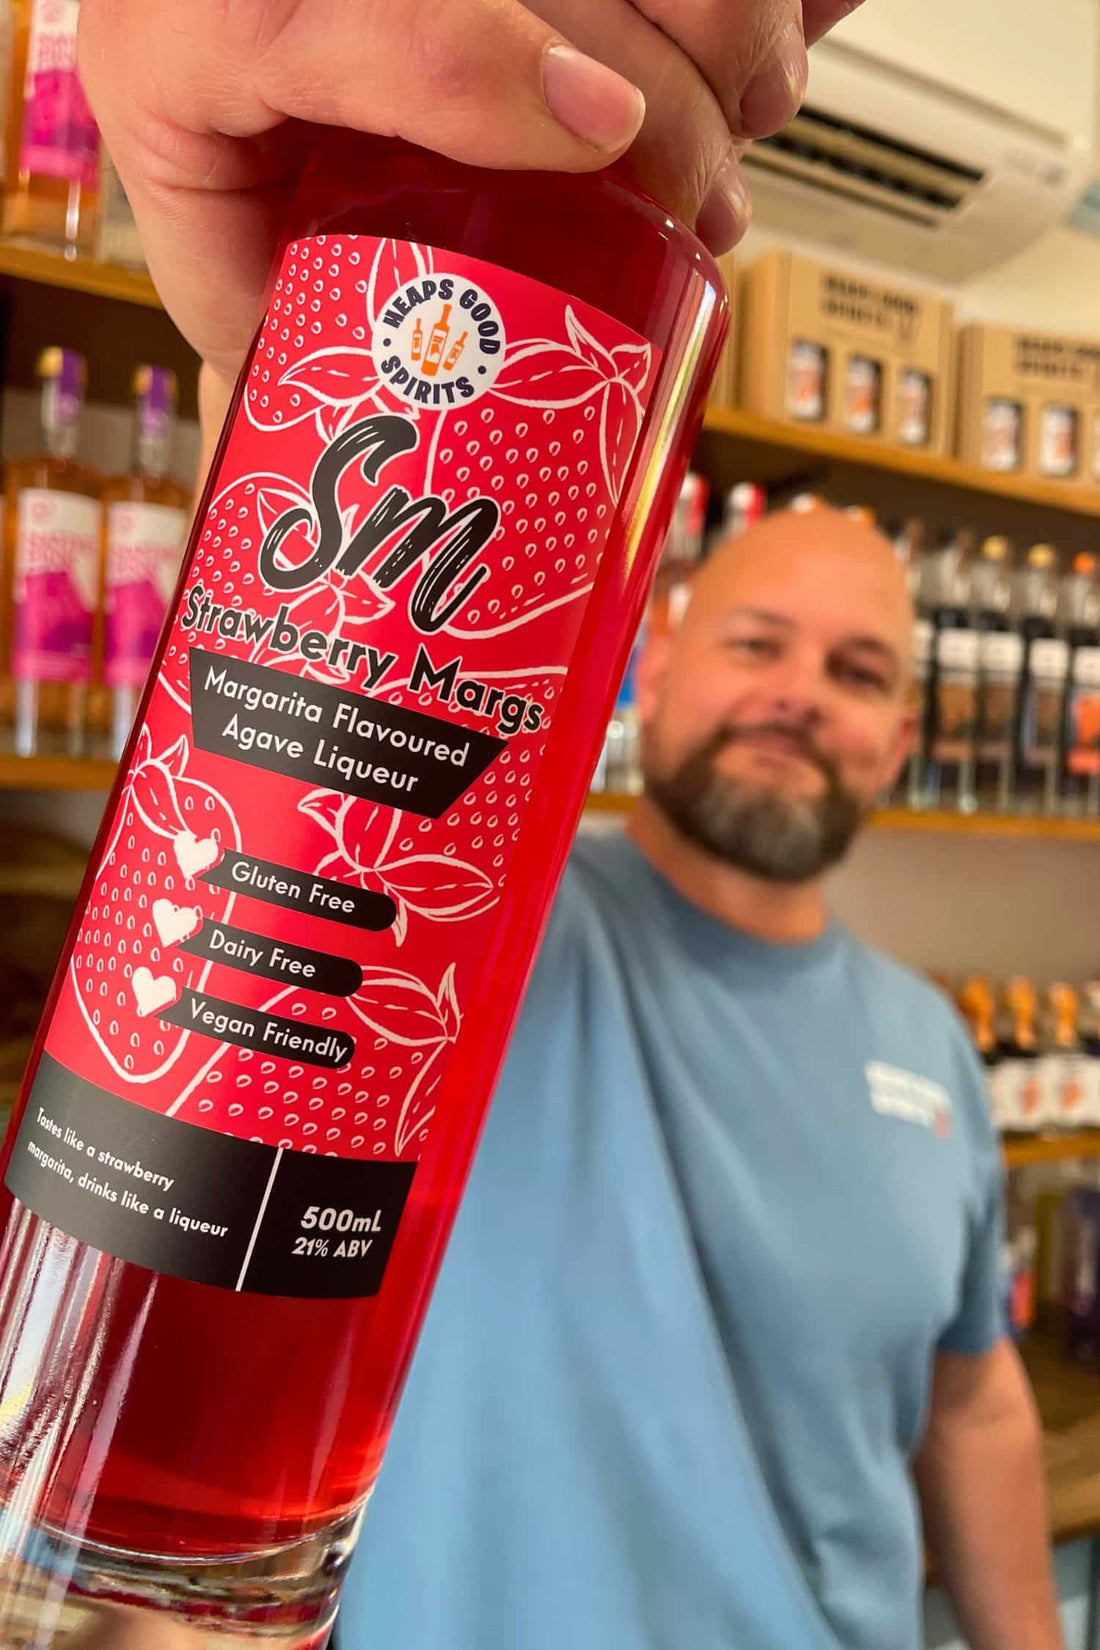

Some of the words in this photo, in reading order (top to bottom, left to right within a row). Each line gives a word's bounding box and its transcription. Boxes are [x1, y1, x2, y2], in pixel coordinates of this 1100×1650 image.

[383, 279, 454, 329] HEAPS
[459, 289, 501, 355] GOOD
[381, 355, 474, 404] SPIRITS
[260, 415, 499, 633] Sm
[182, 585, 398, 689] Strawberry
[408, 644, 544, 734] Margs
[204, 665, 323, 723] Margarita
[332, 702, 470, 767] Flavoured
[222, 713, 304, 759] Agave
[313, 739, 419, 792] Liqueur
[231, 861, 301, 899] Gluten
[308, 883, 355, 914] Free
[209, 929, 263, 966] Dairy
[269, 948, 316, 978] Free
[191, 998, 255, 1037] Vegan
[263, 1022, 348, 1063] Friendly
[36, 1106, 62, 1139] Tastes
[64, 1126, 84, 1152] like
[86, 1145, 96, 1156] a
[97, 1150, 175, 1191] strawberry
[27, 1140, 75, 1184] margarita,
[77, 1171, 118, 1203] drinks
[121, 1191, 149, 1216] like
[153, 1207, 164, 1220] a
[169, 1210, 229, 1238] liqueur
[300, 1206, 382, 1233] 500mL
[291, 1237, 329, 1257] 21%
[333, 1239, 374, 1258] ABV
